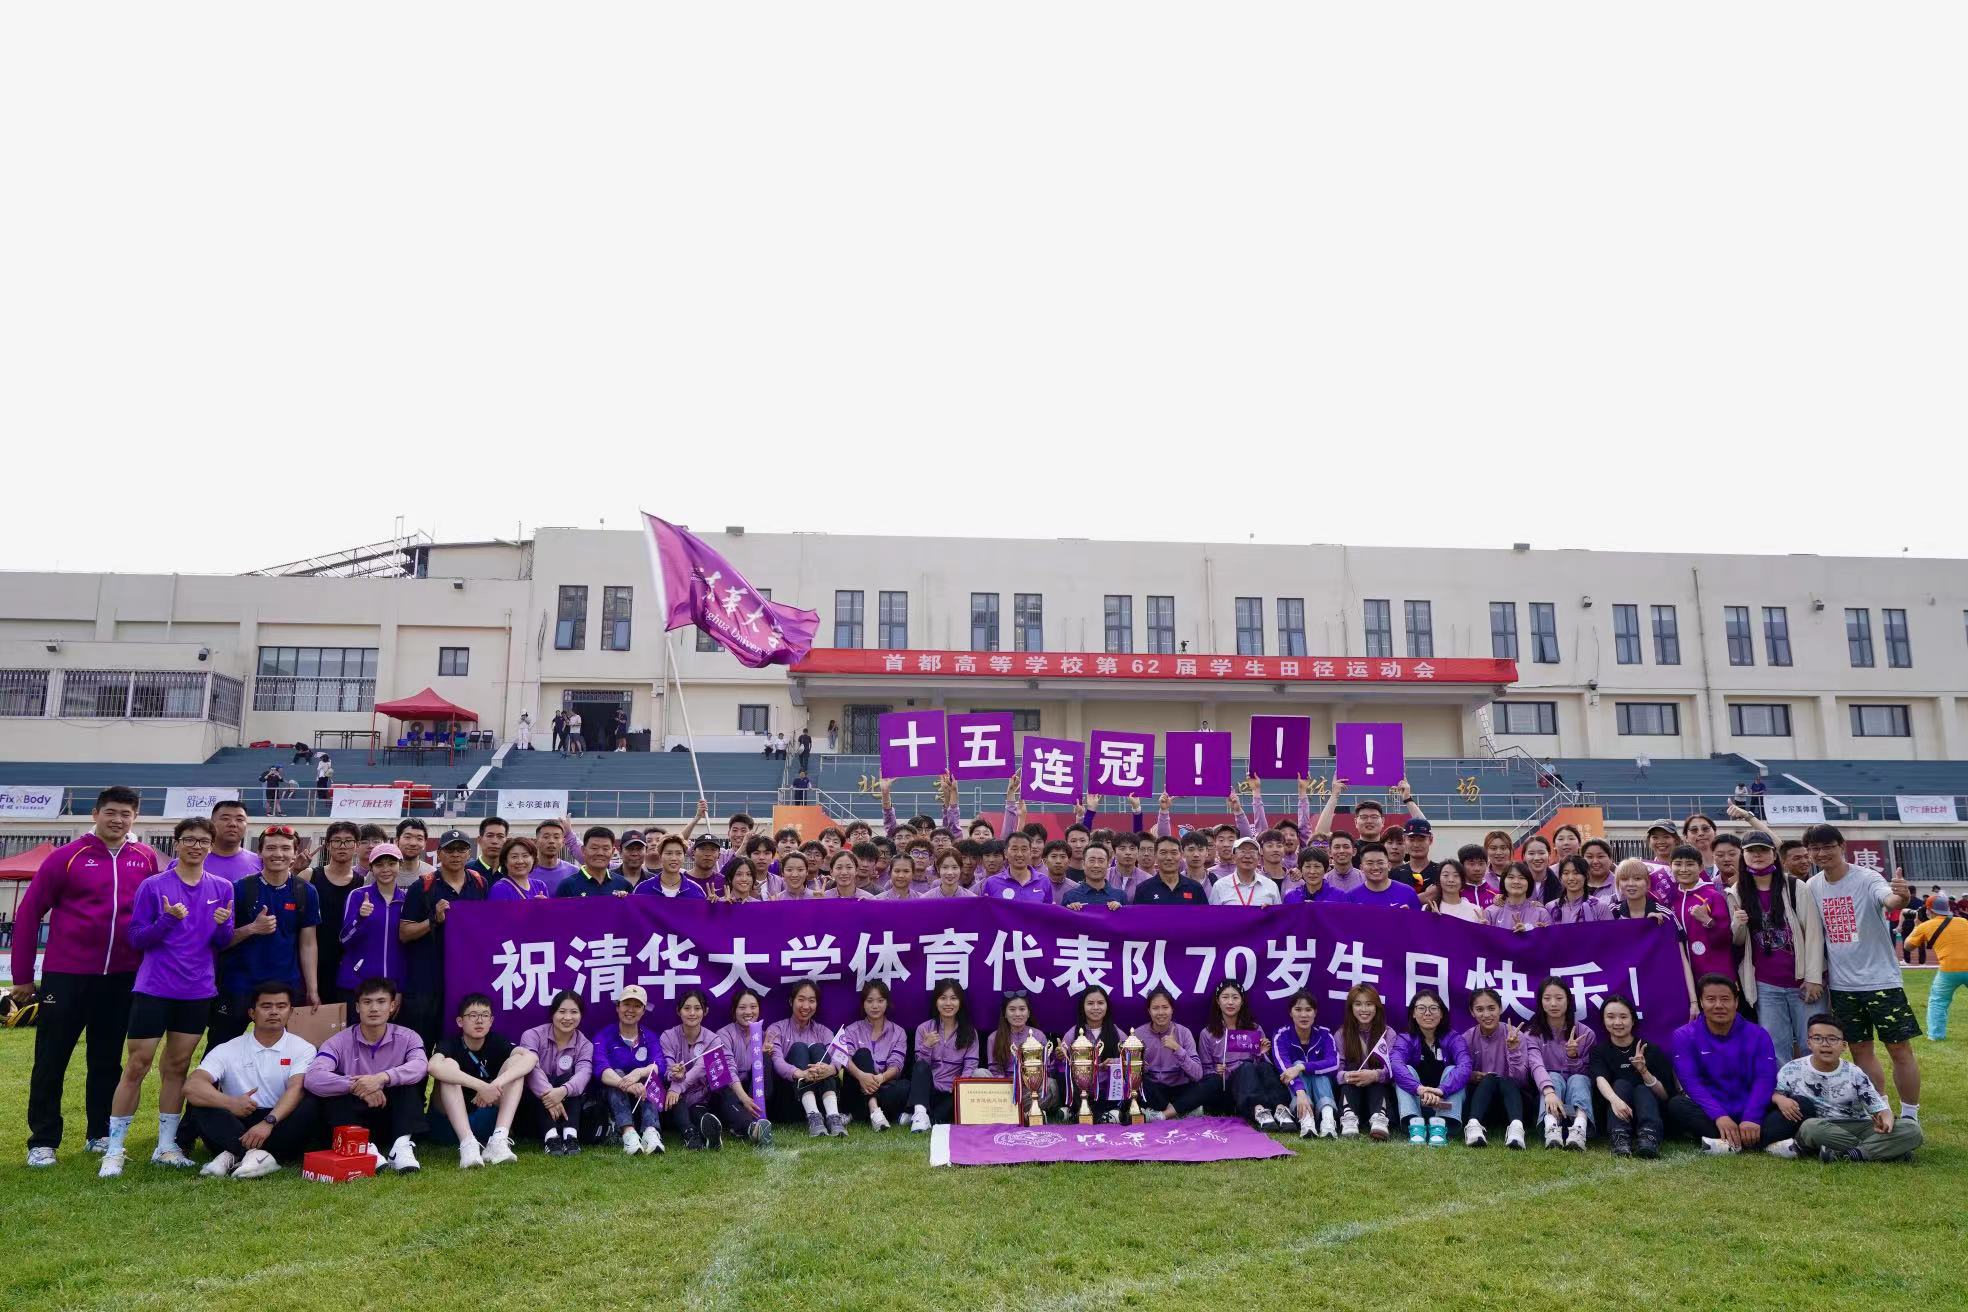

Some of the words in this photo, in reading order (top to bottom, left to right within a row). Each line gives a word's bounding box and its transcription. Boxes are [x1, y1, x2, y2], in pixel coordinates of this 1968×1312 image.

[883, 653, 1436, 677] 首都高等学校第62届学生田径运动会
[517, 800, 561, 809] 卡尔美体育
[1853, 847, 1885, 873] 康
